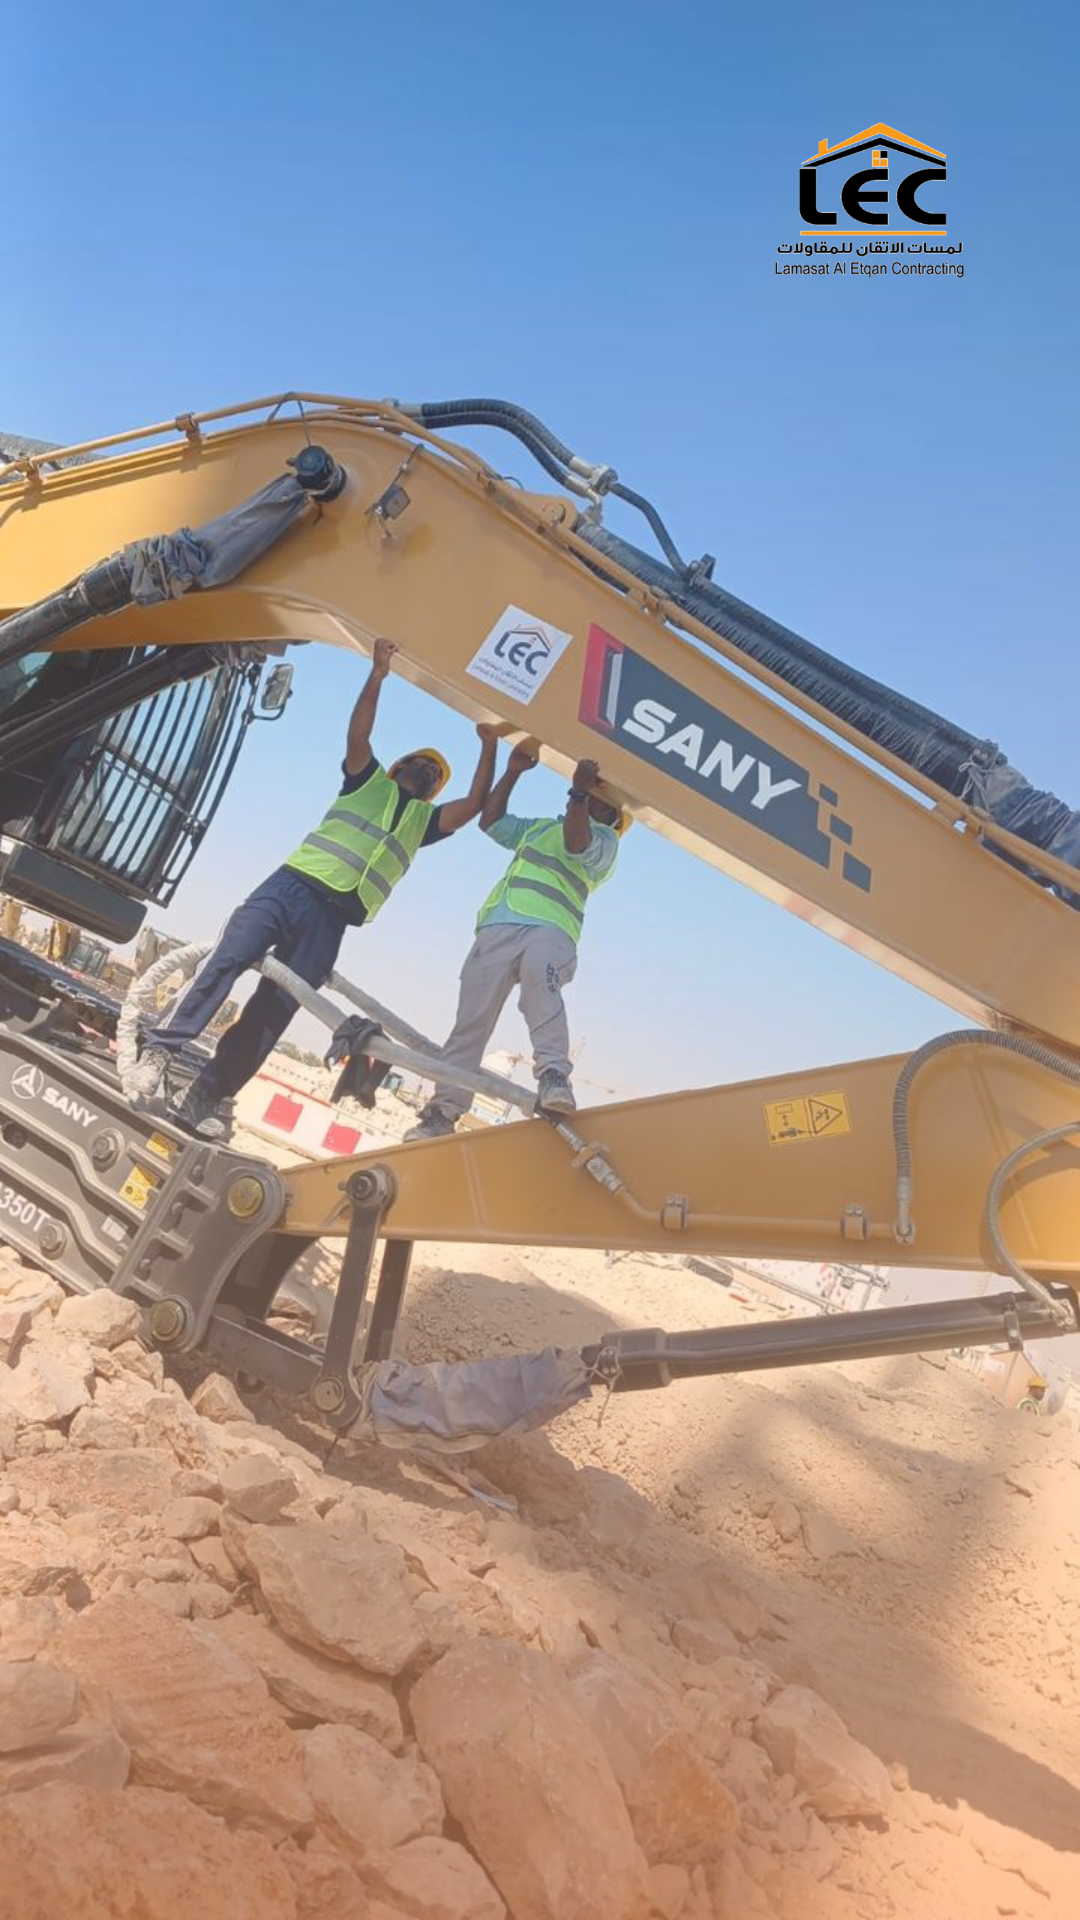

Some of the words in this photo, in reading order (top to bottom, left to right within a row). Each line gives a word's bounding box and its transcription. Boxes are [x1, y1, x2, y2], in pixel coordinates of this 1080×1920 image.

[494, 630, 549, 676] LEC
[621, 698, 802, 810] SANY
[41, 1086, 99, 1127] SANY
[0, 1182, 51, 1232] 350T
